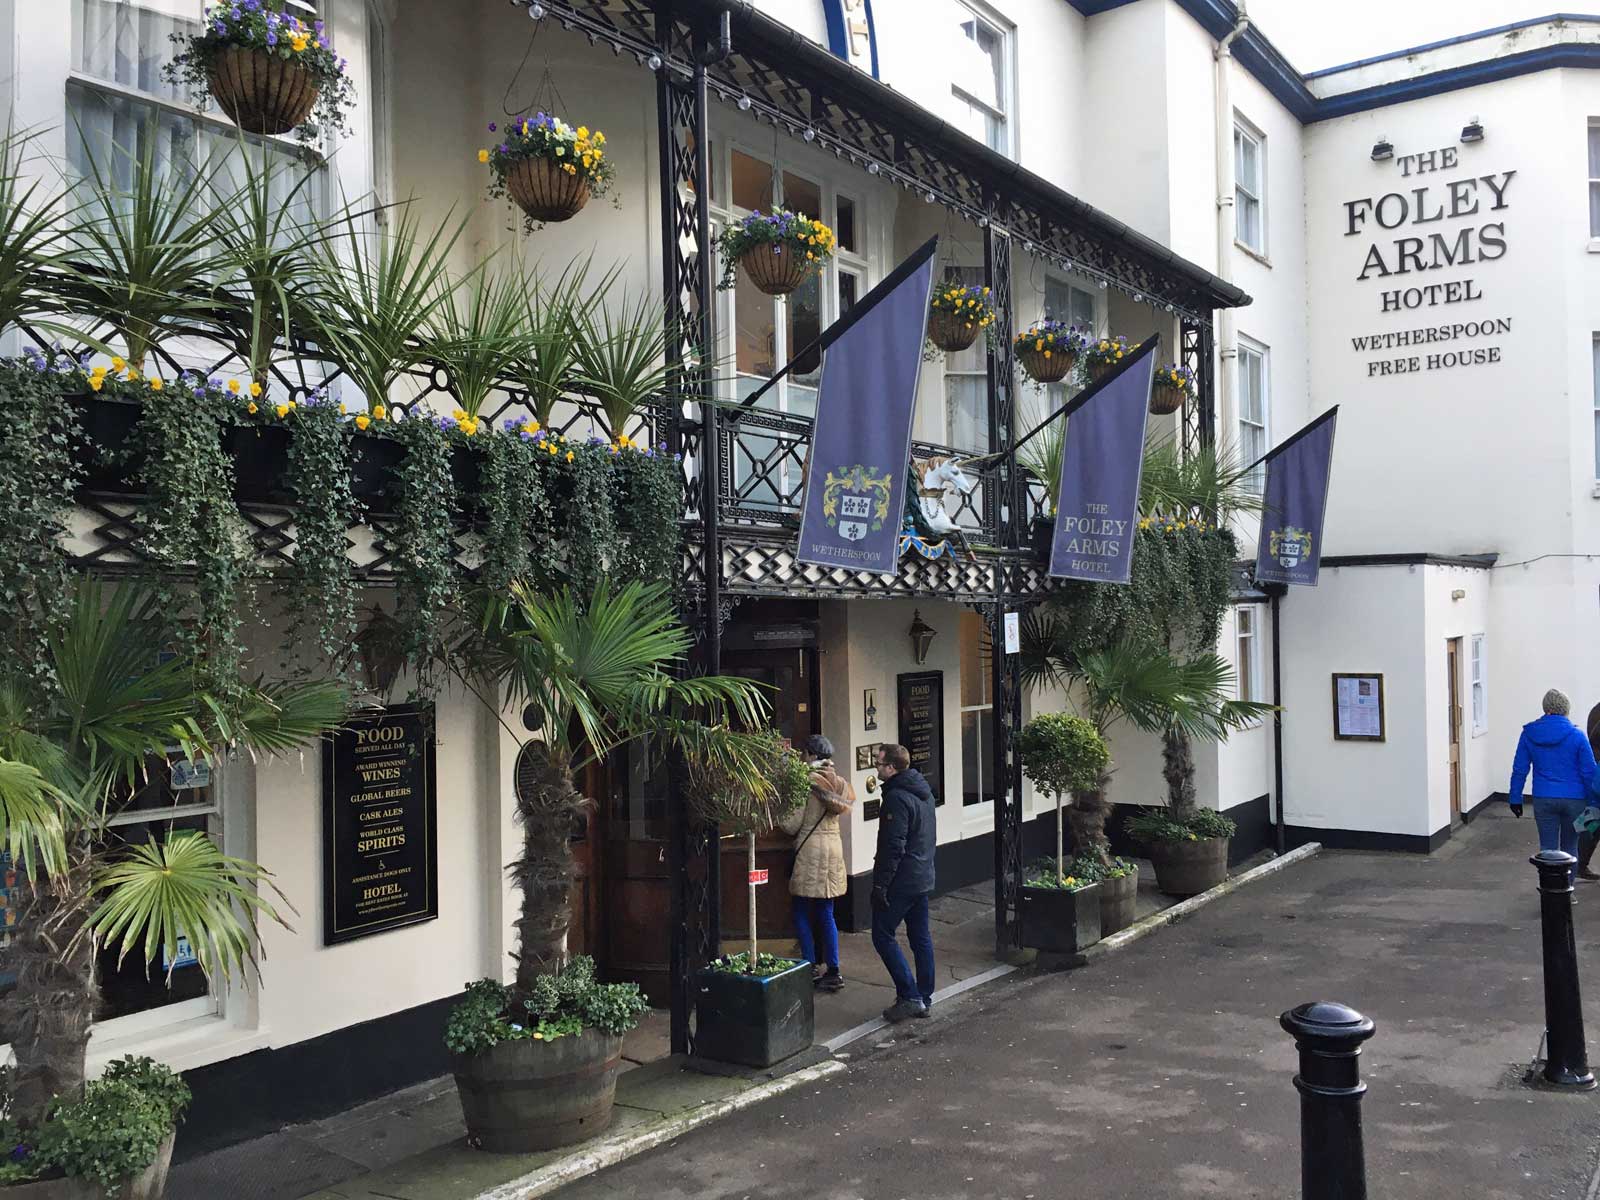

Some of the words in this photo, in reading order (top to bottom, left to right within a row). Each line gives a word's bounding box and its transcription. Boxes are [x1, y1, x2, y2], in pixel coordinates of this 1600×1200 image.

[1397, 146, 1458, 178] THE
[1343, 170, 1517, 237] FOLEY
[1356, 222, 1507, 281] ARMS
[1380, 279, 1482, 313] HOTEL
[1352, 317, 1512, 352] WETHERSPOON
[1367, 356, 1420, 377] FREE
[1426, 347, 1501, 370] HOUSE
[1086, 503, 1108, 514] THE
[1063, 516, 1128, 536] FOLEY
[812, 543, 881, 561] WETHERSPOON
[1065, 538, 1120, 557] ARMS
[1071, 559, 1112, 573] HOTEL
[357, 726, 404, 745] FOOD
[354, 745, 380, 754] SERVED
[381, 743, 393, 751] ALL
[355, 762, 378, 772] AWARD
[362, 767, 401, 782] WINES
[350, 791, 384, 803] GLOBAL
[385, 787, 412, 798] BEERS
[359, 810, 382, 821] CASK
[382, 807, 404, 818] ALES
[359, 828, 383, 838] WORLD
[383, 825, 404, 835] CLASS
[357, 833, 406, 853] SPIRITS
[363, 882, 402, 900] HOTEL
